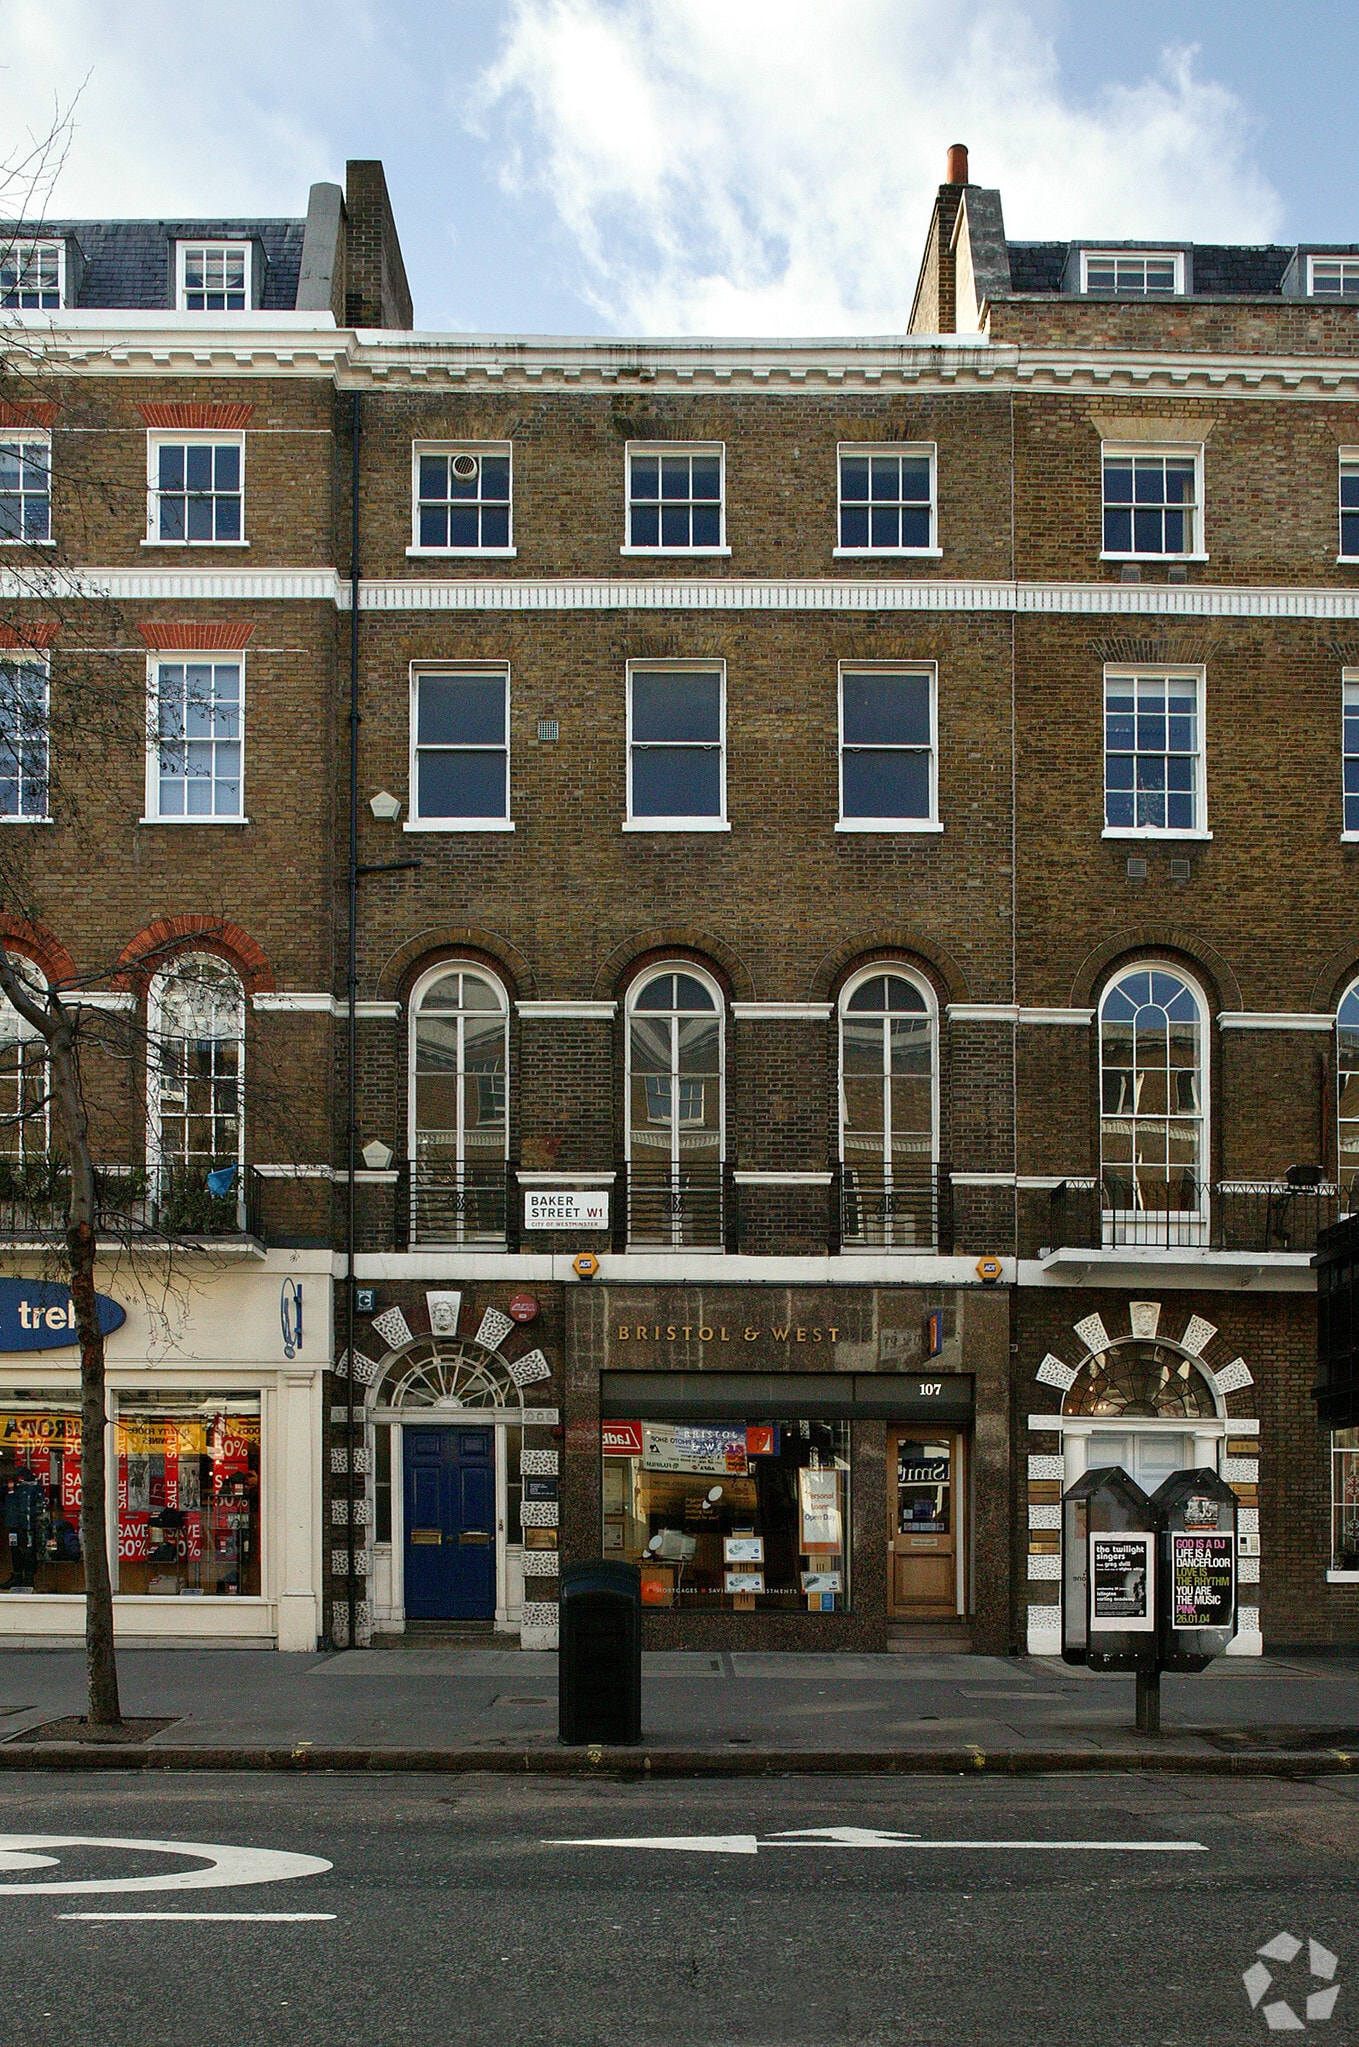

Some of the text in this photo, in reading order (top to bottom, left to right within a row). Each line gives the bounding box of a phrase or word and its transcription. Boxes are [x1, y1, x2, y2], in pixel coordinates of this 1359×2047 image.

[531, 1196, 574, 1206] BAKER
[531, 1208, 603, 1218] STREET W1
[618, 1326, 840, 1342] BRISTOL & WEST
[919, 1383, 942, 1396] 107
[684, 1430, 738, 1439] BRISTOL
[64, 1438, 82, 1455] 50
[705, 1443, 737, 1451] WEST
[118, 1480, 127, 1509] SALE
[167, 1480, 177, 1509] SALE
[804, 1513, 822, 1522] Open
[118, 1524, 149, 1537] SAVE
[178, 1540, 200, 1557] 0%
[1176, 1539, 1226, 1549] GOD IS A DJ
[1096, 1545, 1145, 1555] the twilight
[1176, 1549, 1212, 1558] LIFE IS A
[1096, 1552, 1126, 1561] singers
[1176, 1558, 1231, 1568] DANCEFLOOR
[1176, 1568, 1208, 1577] LOVE IS
[1176, 1577, 1230, 1586] THE RHYTHM
[1176, 1586, 1212, 1596] YOU ARE
[1176, 1595, 1221, 1605] THE MUSIC
[1176, 1605, 1197, 1614] PINK
[1176, 1614, 1210, 1624] 26.01.04
